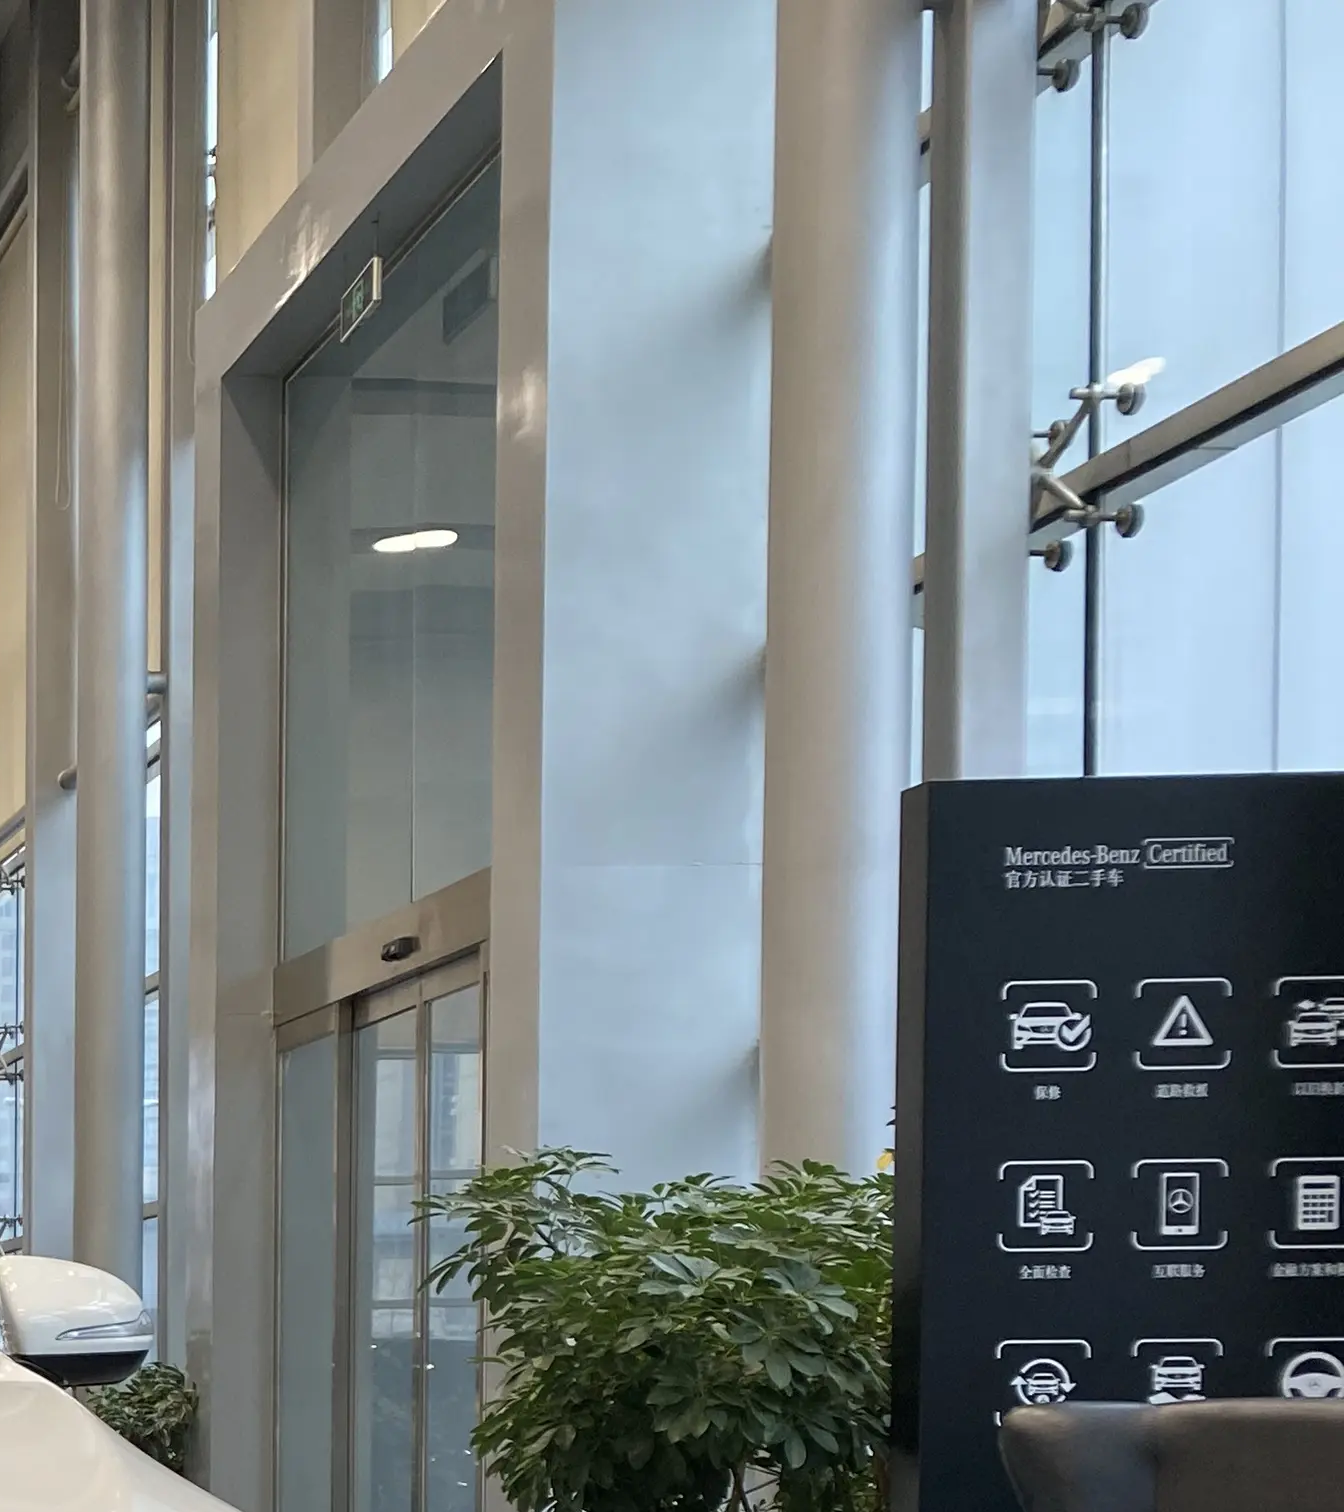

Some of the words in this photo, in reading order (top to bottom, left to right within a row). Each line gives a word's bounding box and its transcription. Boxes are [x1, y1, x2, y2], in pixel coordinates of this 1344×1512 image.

[1004, 845, 1140, 867] Mercedes-Benz
[1147, 843, 1227, 864] Certified
[1004, 868, 1124, 889] 官方认证二手车
[1019, 1264, 1072, 1280] 全面检查
